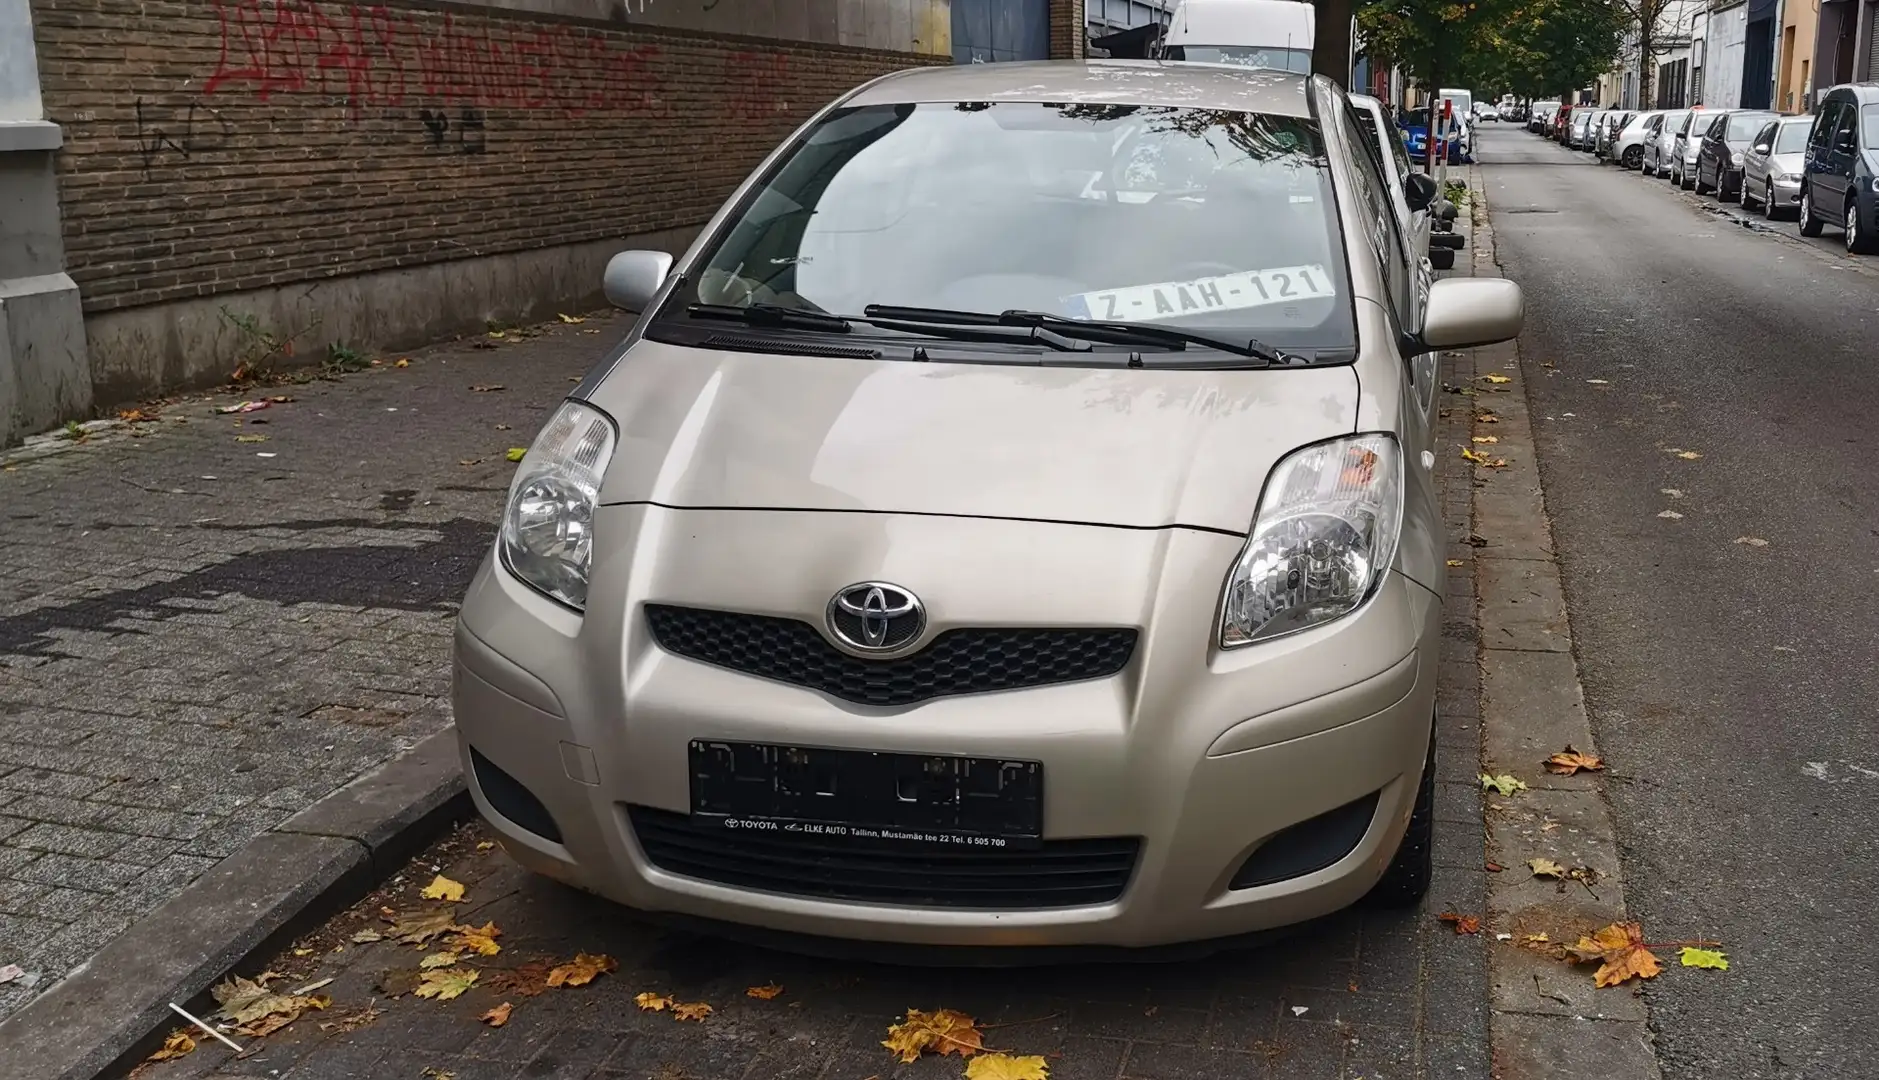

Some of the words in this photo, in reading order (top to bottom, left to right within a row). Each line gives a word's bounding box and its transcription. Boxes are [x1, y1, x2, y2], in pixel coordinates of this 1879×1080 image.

[1098, 270, 1319, 320] Z-AAH-121
[740, 820, 778, 830] TOYOTA
[804, 824, 824, 833] ELKE
[825, 826, 847, 835] AUTO
[850, 828, 880, 838] Tallinn,
[939, 834, 950, 842] 22
[951, 835, 966, 844] Tel.
[974, 837, 989, 846] 505
[990, 838, 1006, 847] 700
